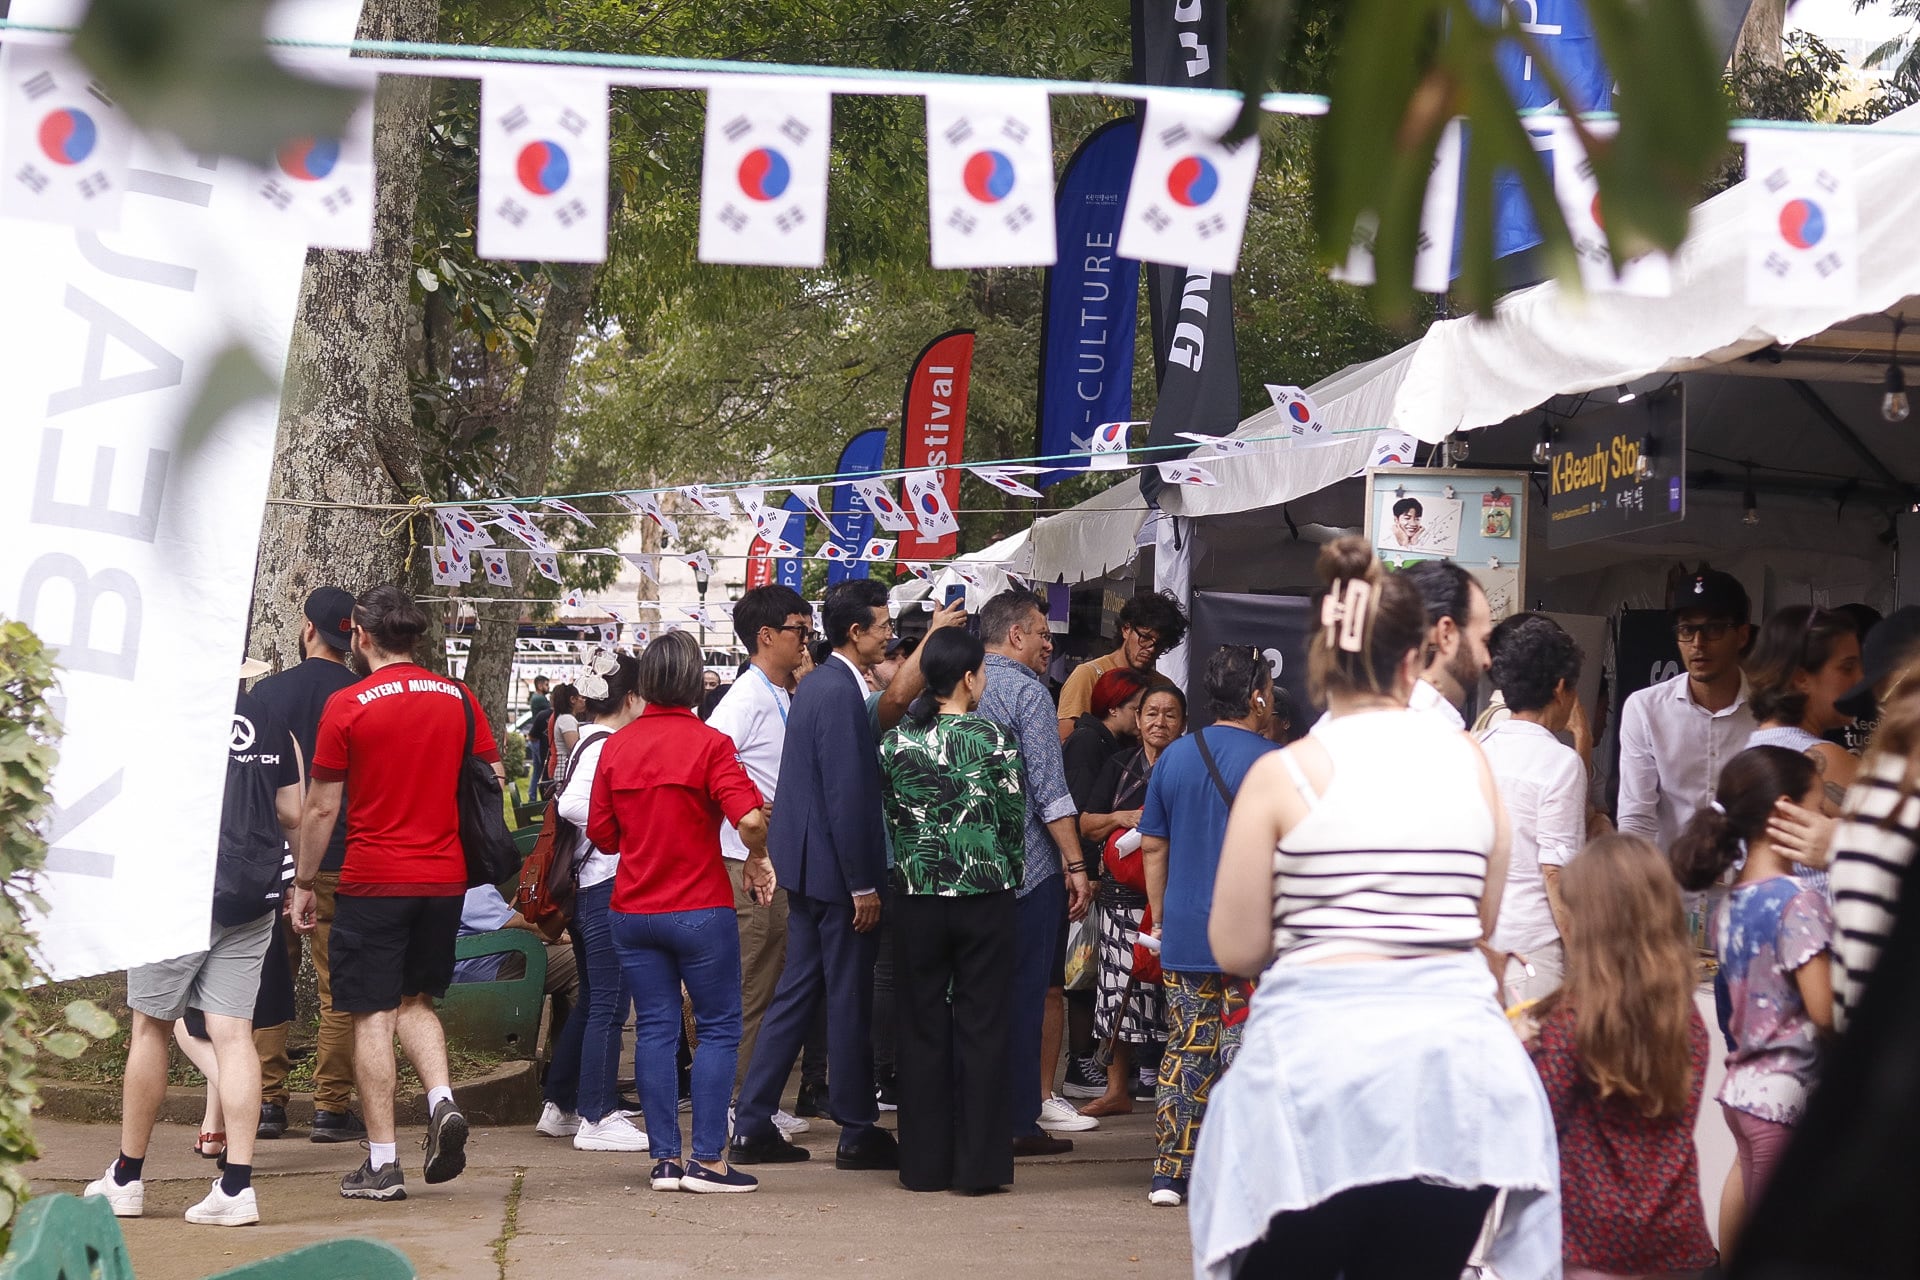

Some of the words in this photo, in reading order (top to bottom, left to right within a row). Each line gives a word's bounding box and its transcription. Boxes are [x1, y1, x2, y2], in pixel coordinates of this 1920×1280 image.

[1068, 232, 1113, 456] K-CULTURE
[1552, 442, 1609, 495] K-Beauty
[356, 681, 404, 705] BAYERN
